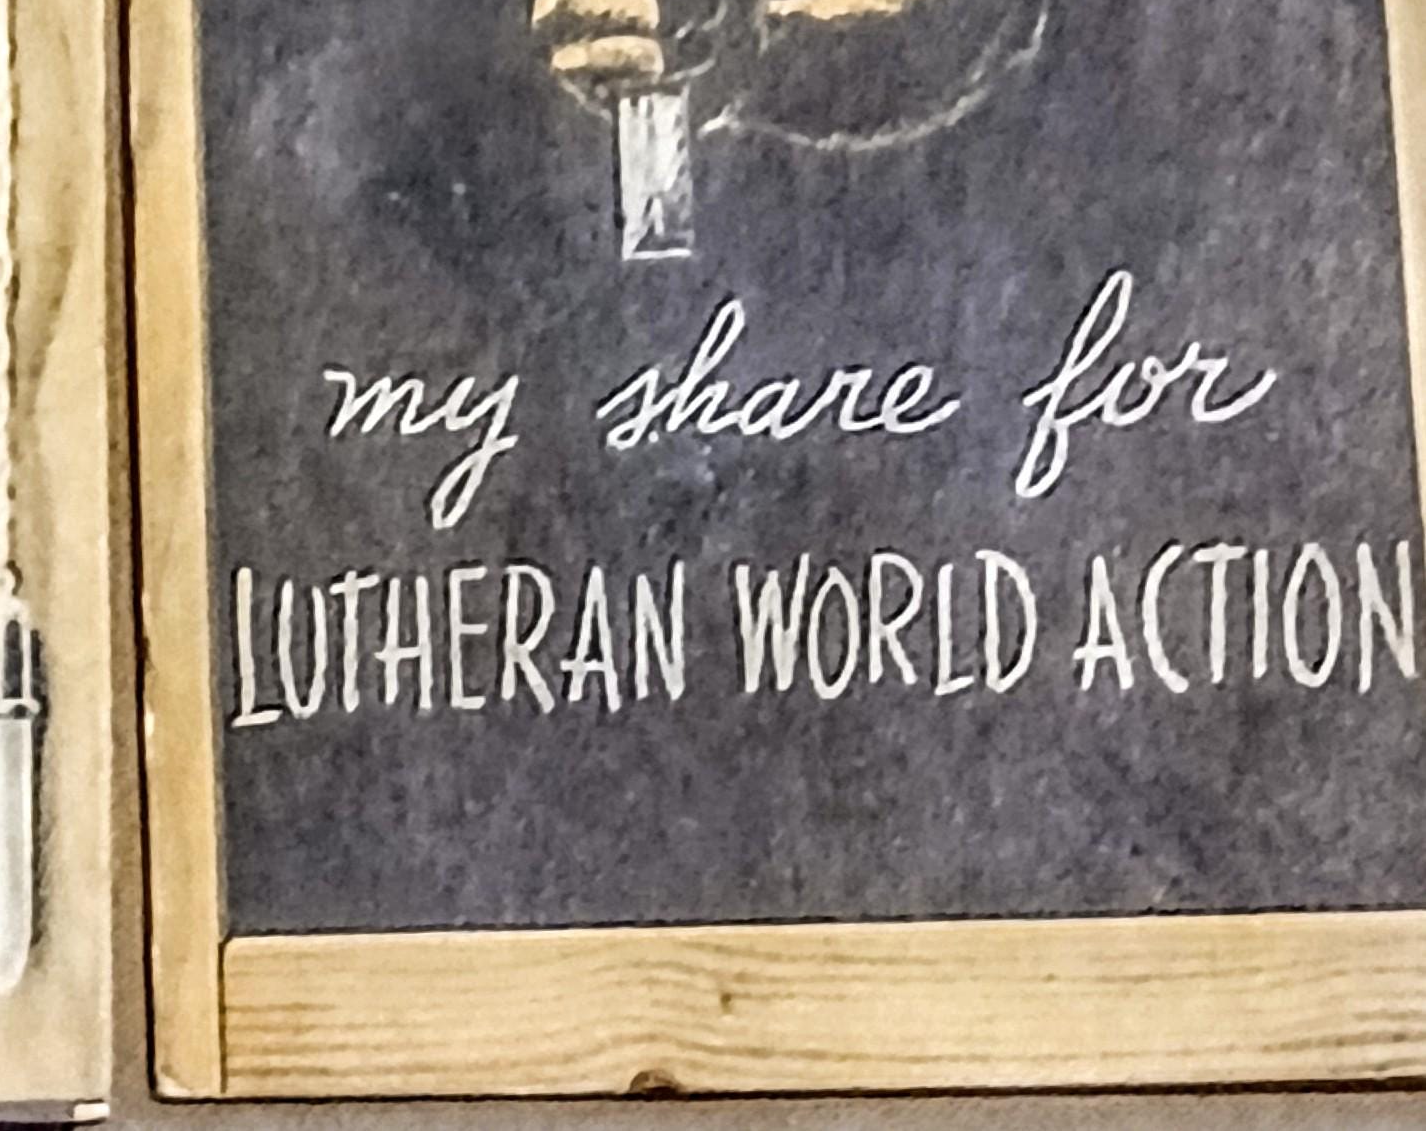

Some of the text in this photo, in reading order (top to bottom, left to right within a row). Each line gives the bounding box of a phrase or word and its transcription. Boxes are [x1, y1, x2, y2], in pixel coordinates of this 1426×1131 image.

[323, 269, 1277, 530] my share for
[233, 538, 1418, 727] LUTHERAN WORLD ACTION
